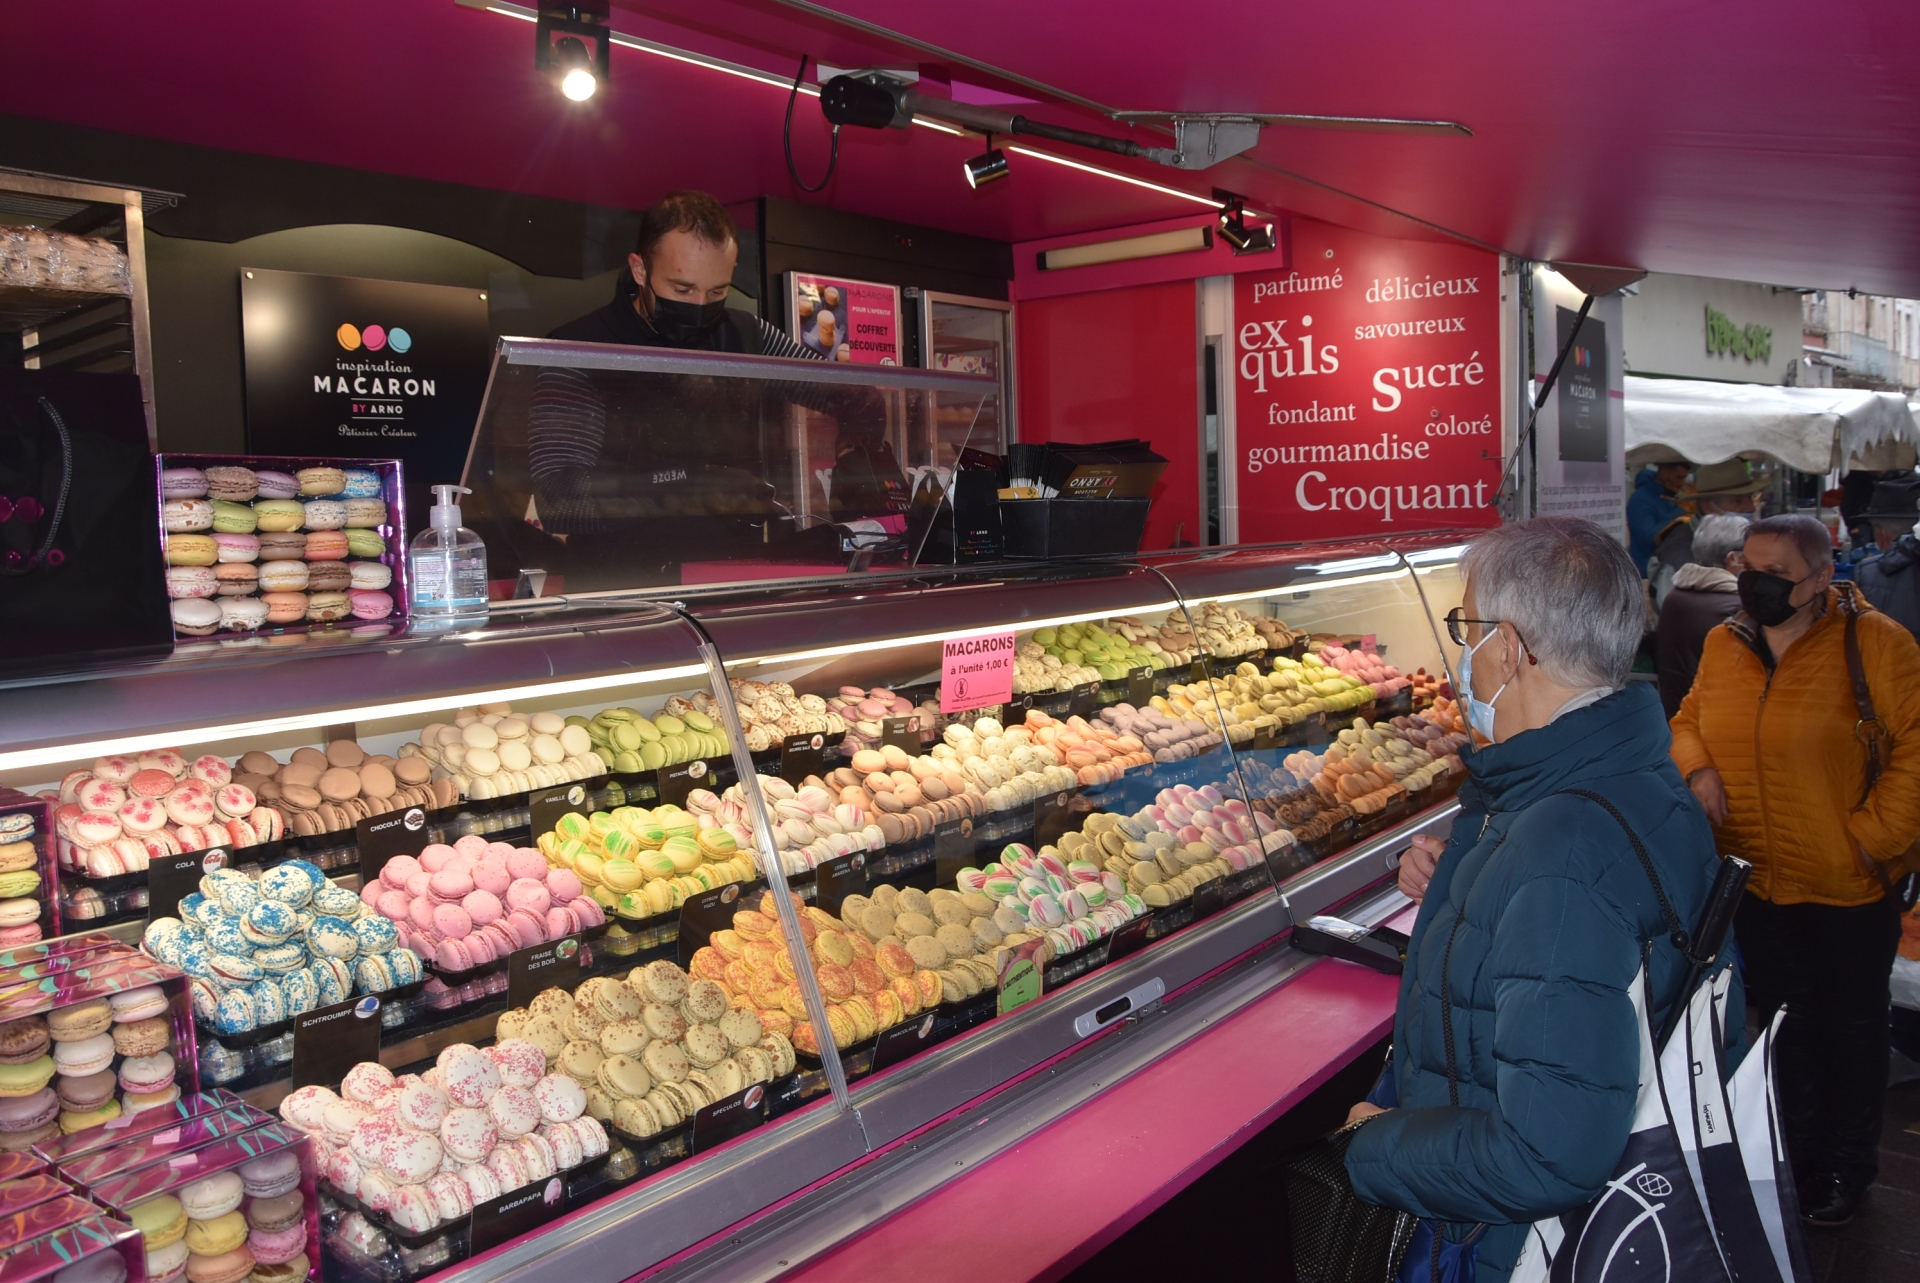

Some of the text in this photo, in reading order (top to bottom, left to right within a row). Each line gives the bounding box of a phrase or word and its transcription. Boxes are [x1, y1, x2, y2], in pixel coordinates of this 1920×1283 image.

[1254, 268, 1343, 303] parfumé
[1365, 275, 1479, 303] délicieux
[852, 305, 866, 313] POUR
[856, 323, 888, 336] COFFRET
[1355, 317, 1466, 340] savoureux
[849, 338, 896, 353] DÉCOUVERTE
[336, 358, 413, 377] inspiration
[314, 375, 436, 397] MACARON
[1372, 350, 1484, 412] Sucré
[352, 404, 403, 414] BY ARNO
[1268, 400, 1356, 425] fondant
[338, 424, 417, 437] Pâtissier Créateur
[1425, 414, 1492, 437] coloré
[1247, 433, 1430, 473] gourmandise
[1069, 478, 1102, 487] ARNO
[1295, 471, 1489, 522] Croquant
[945, 636, 1014, 657] MACARONS
[950, 658, 1009, 675] à l'unité 1,00 €
[669, 770, 689, 778] PISTACHE
[545, 795, 566, 803] VANILLE
[370, 819, 402, 832] CHOCOLAT
[175, 861, 195, 869] COLA
[702, 895, 719, 904] CITRON
[528, 957, 556, 970] DES BOIS
[531, 950, 553, 961] FRAISE
[1003, 964, 1034, 991] L'AUTHENTIQUE
[302, 1009, 352, 1028] SCHTROUMPF
[712, 1100, 742, 1117] SPECULOS
[499, 1191, 542, 1213] BARBAPAPA
